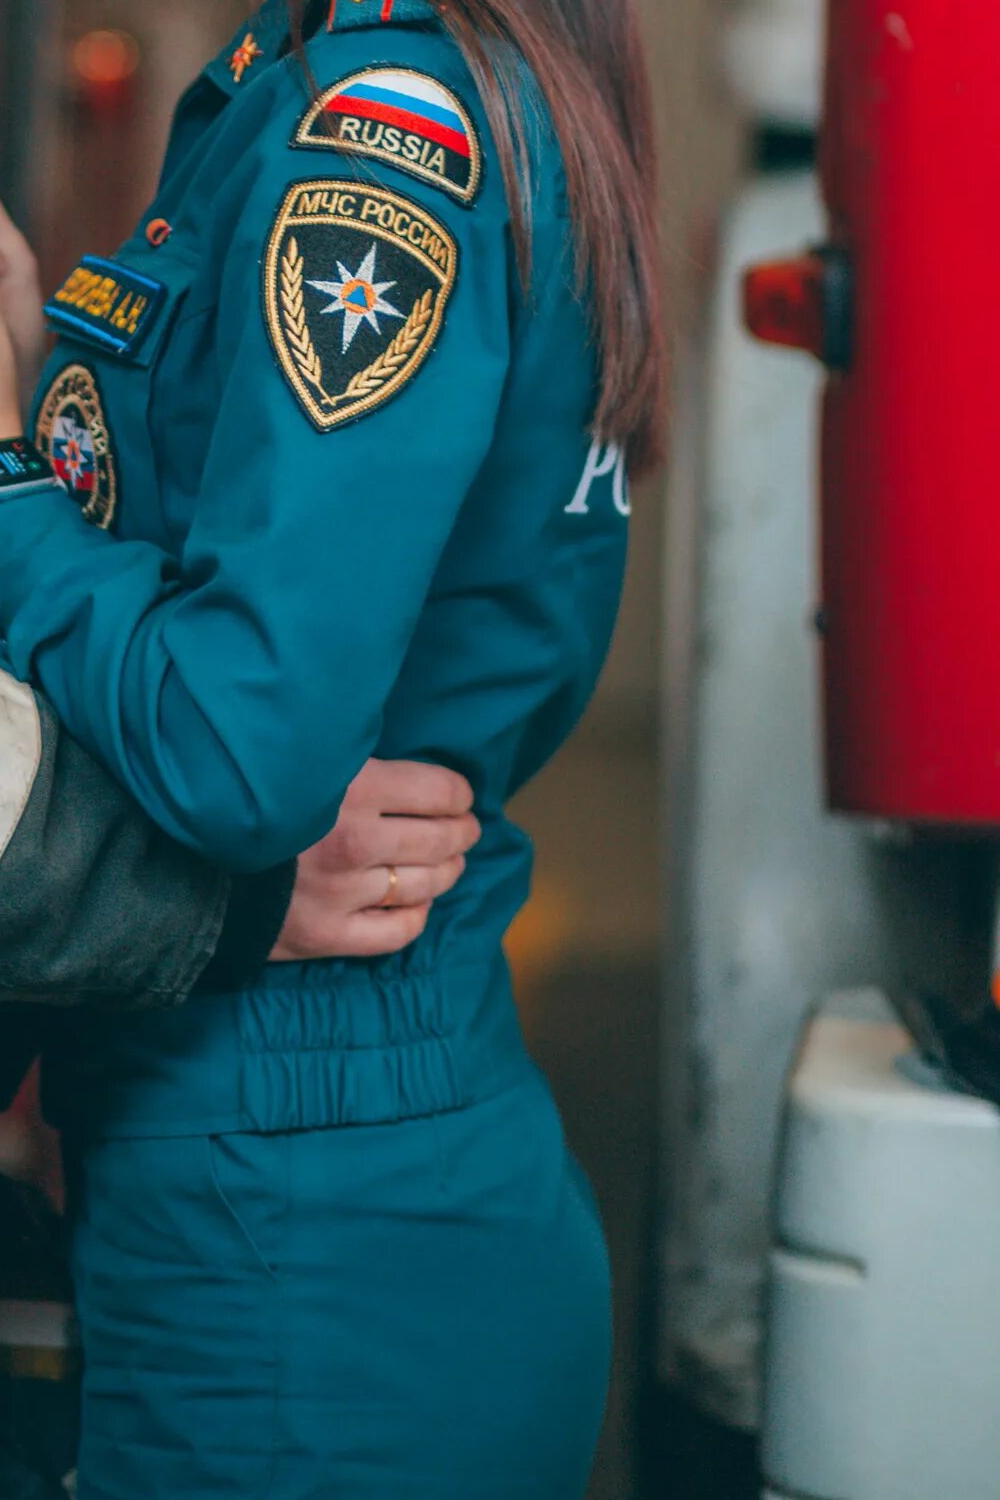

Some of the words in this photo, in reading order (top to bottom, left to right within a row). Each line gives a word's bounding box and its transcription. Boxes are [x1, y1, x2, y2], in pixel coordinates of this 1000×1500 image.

[338, 116, 447, 175] RUSSIA
[297, 192, 357, 216] МЧС
[360, 199, 450, 269] РОССИИ
